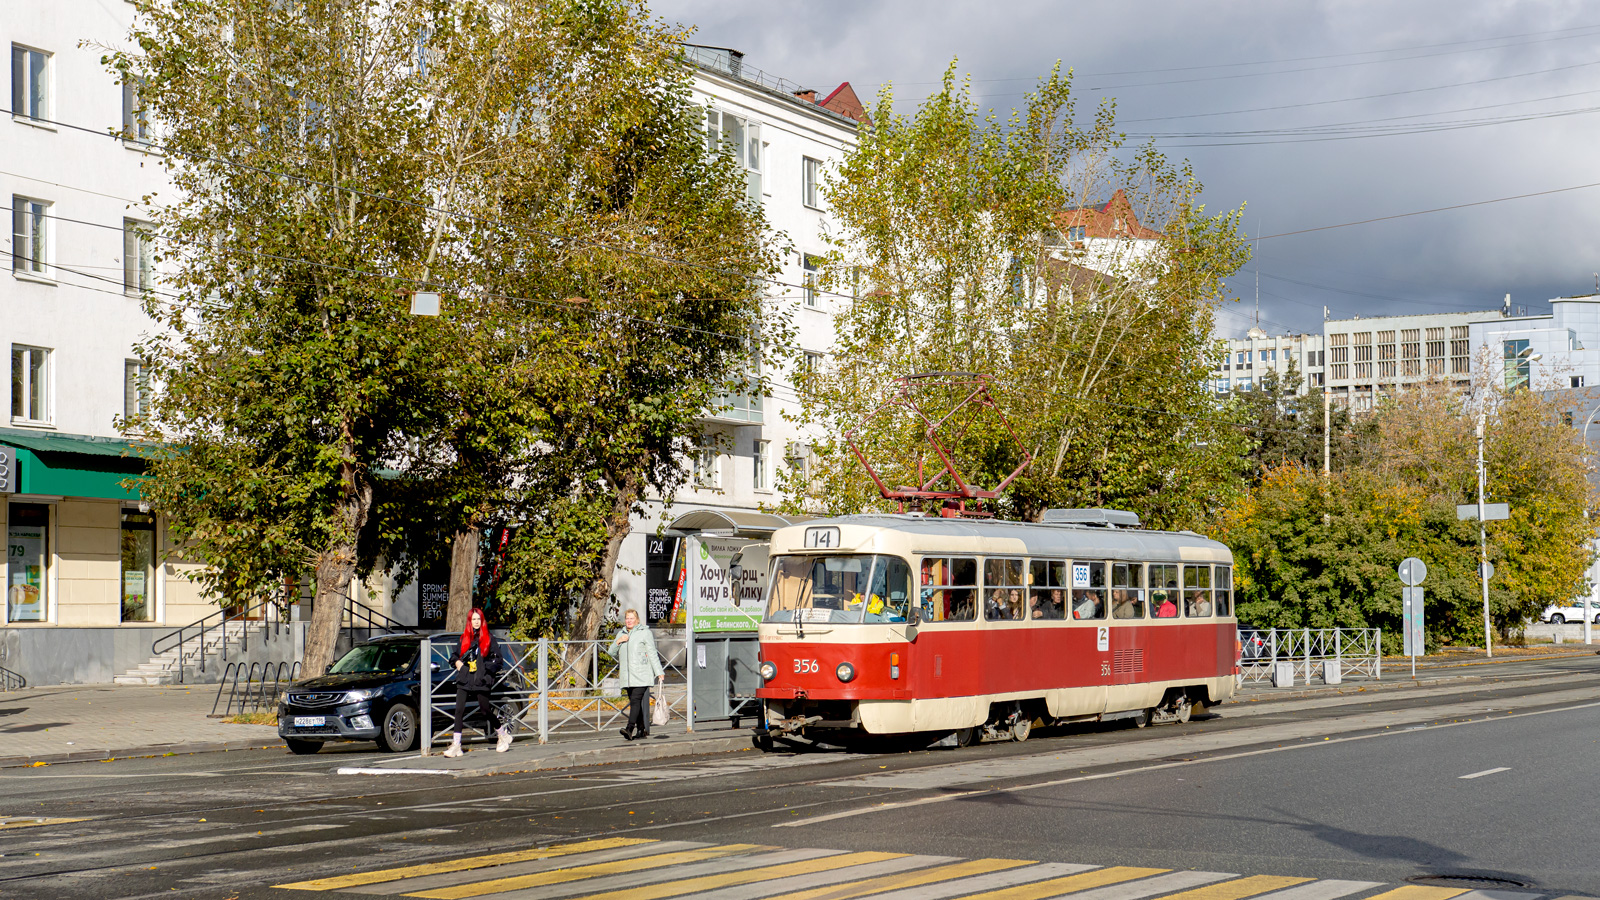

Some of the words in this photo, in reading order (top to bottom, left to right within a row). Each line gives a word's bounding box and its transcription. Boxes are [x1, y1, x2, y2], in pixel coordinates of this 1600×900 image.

[812, 530, 831, 548] 14
[700, 564, 726, 585] Хочу
[1075, 567, 1088, 581] 356
[649, 589, 668, 597] SPRING
[700, 586, 720, 602] иду
[722, 586, 729, 599] в
[731, 583, 763, 603] илку
[422, 602, 442, 610] ВЕСН
[422, 610, 442, 619] ЛЕТО
[793, 658, 819, 673] 356
[1101, 663, 1111, 676] 356
